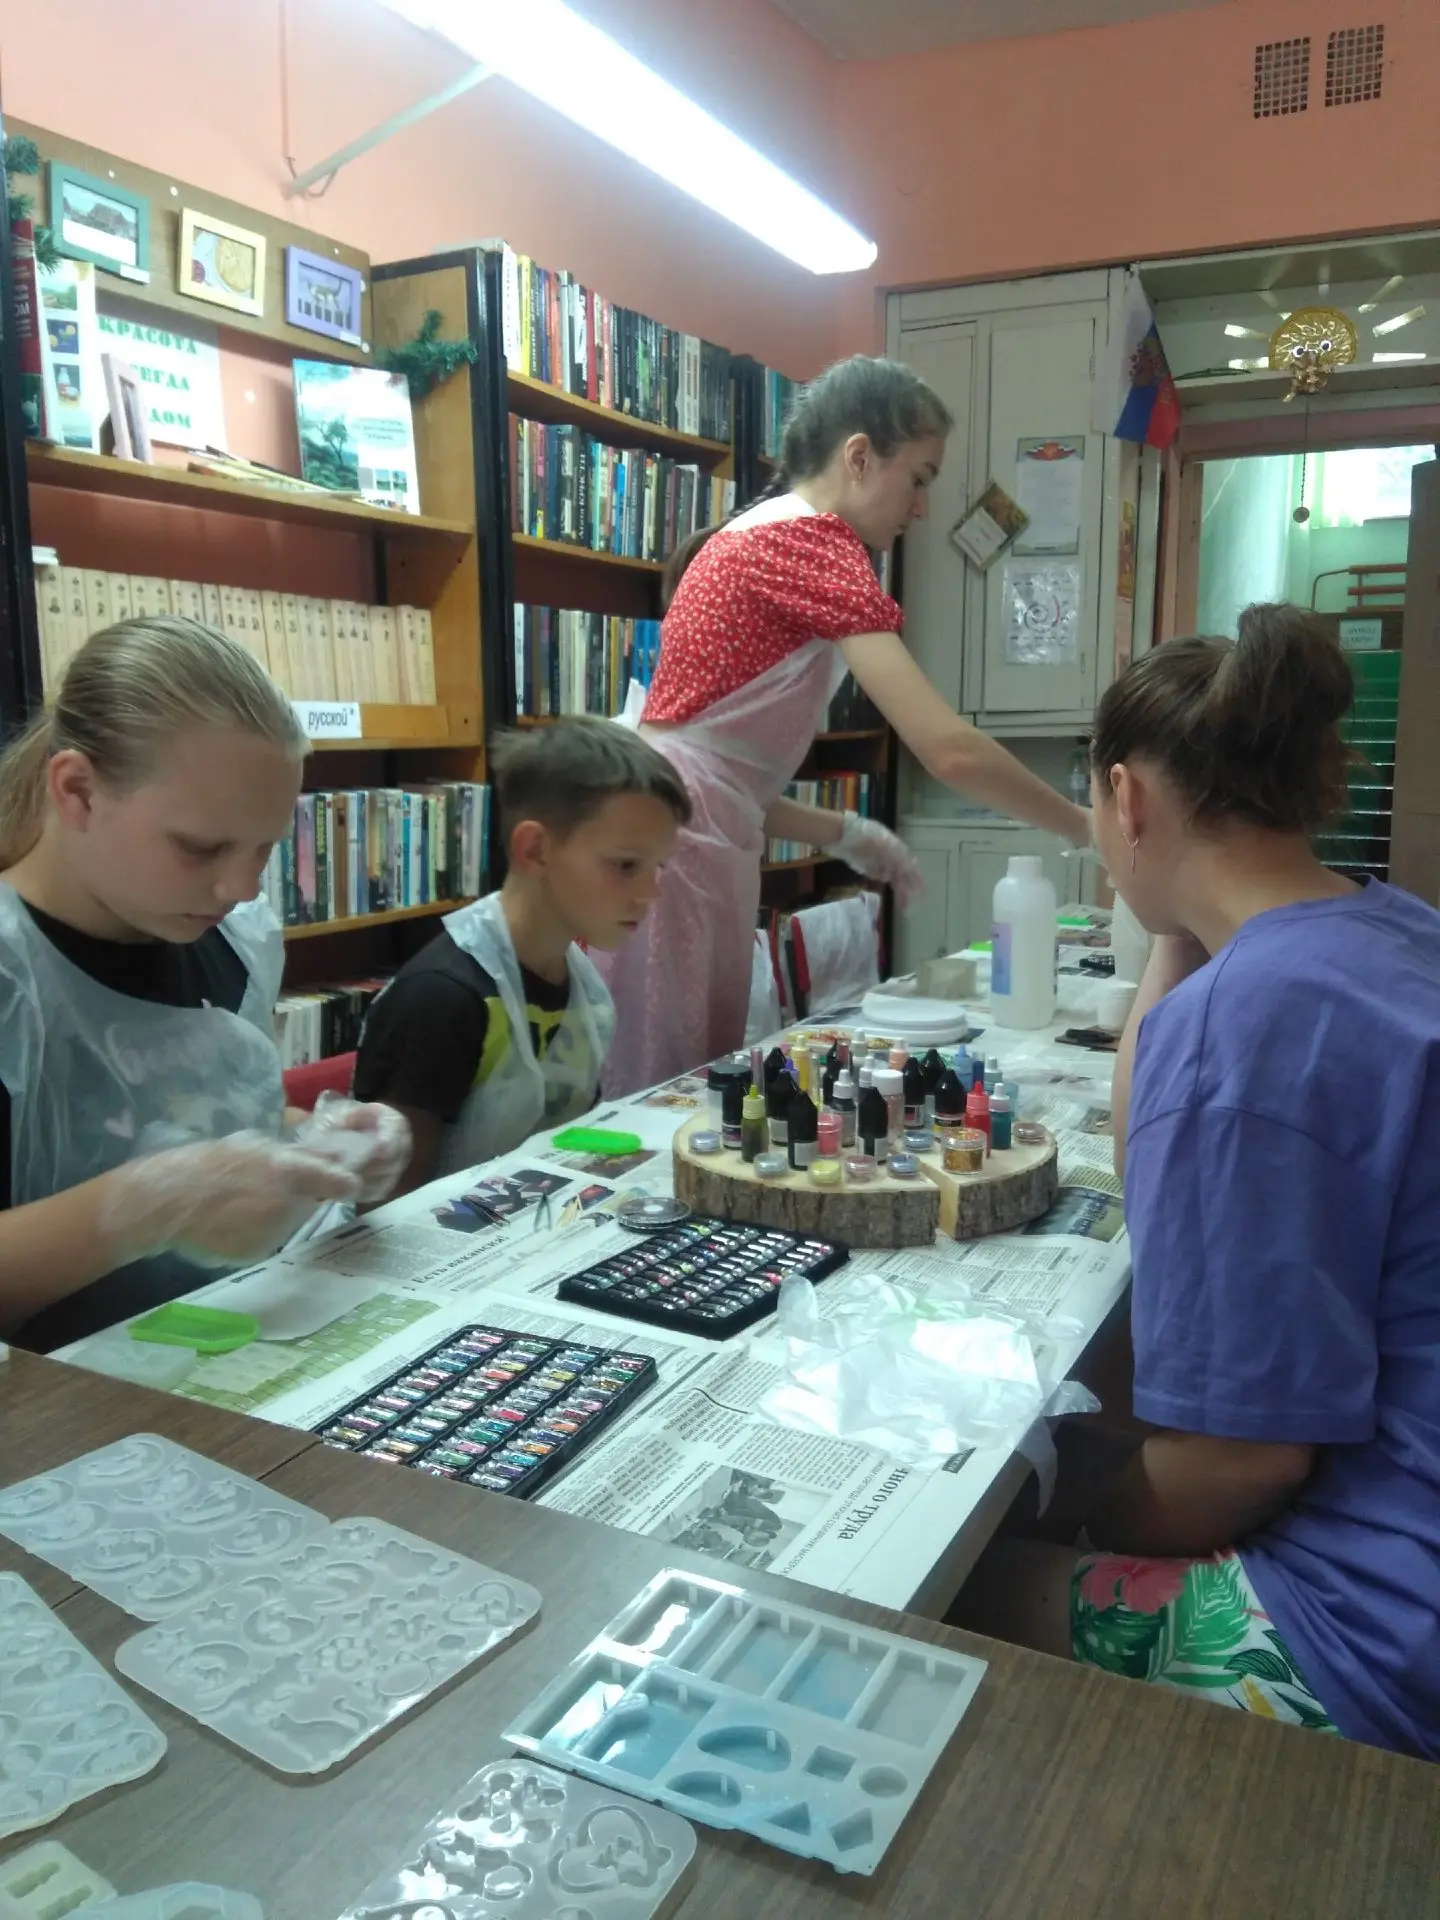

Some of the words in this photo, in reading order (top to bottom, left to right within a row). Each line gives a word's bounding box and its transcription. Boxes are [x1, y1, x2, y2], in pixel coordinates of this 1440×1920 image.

[98, 316, 197, 354] КРАСОТА
[411, 1268, 448, 1284] Есть
[837, 1503, 880, 1541] труда
